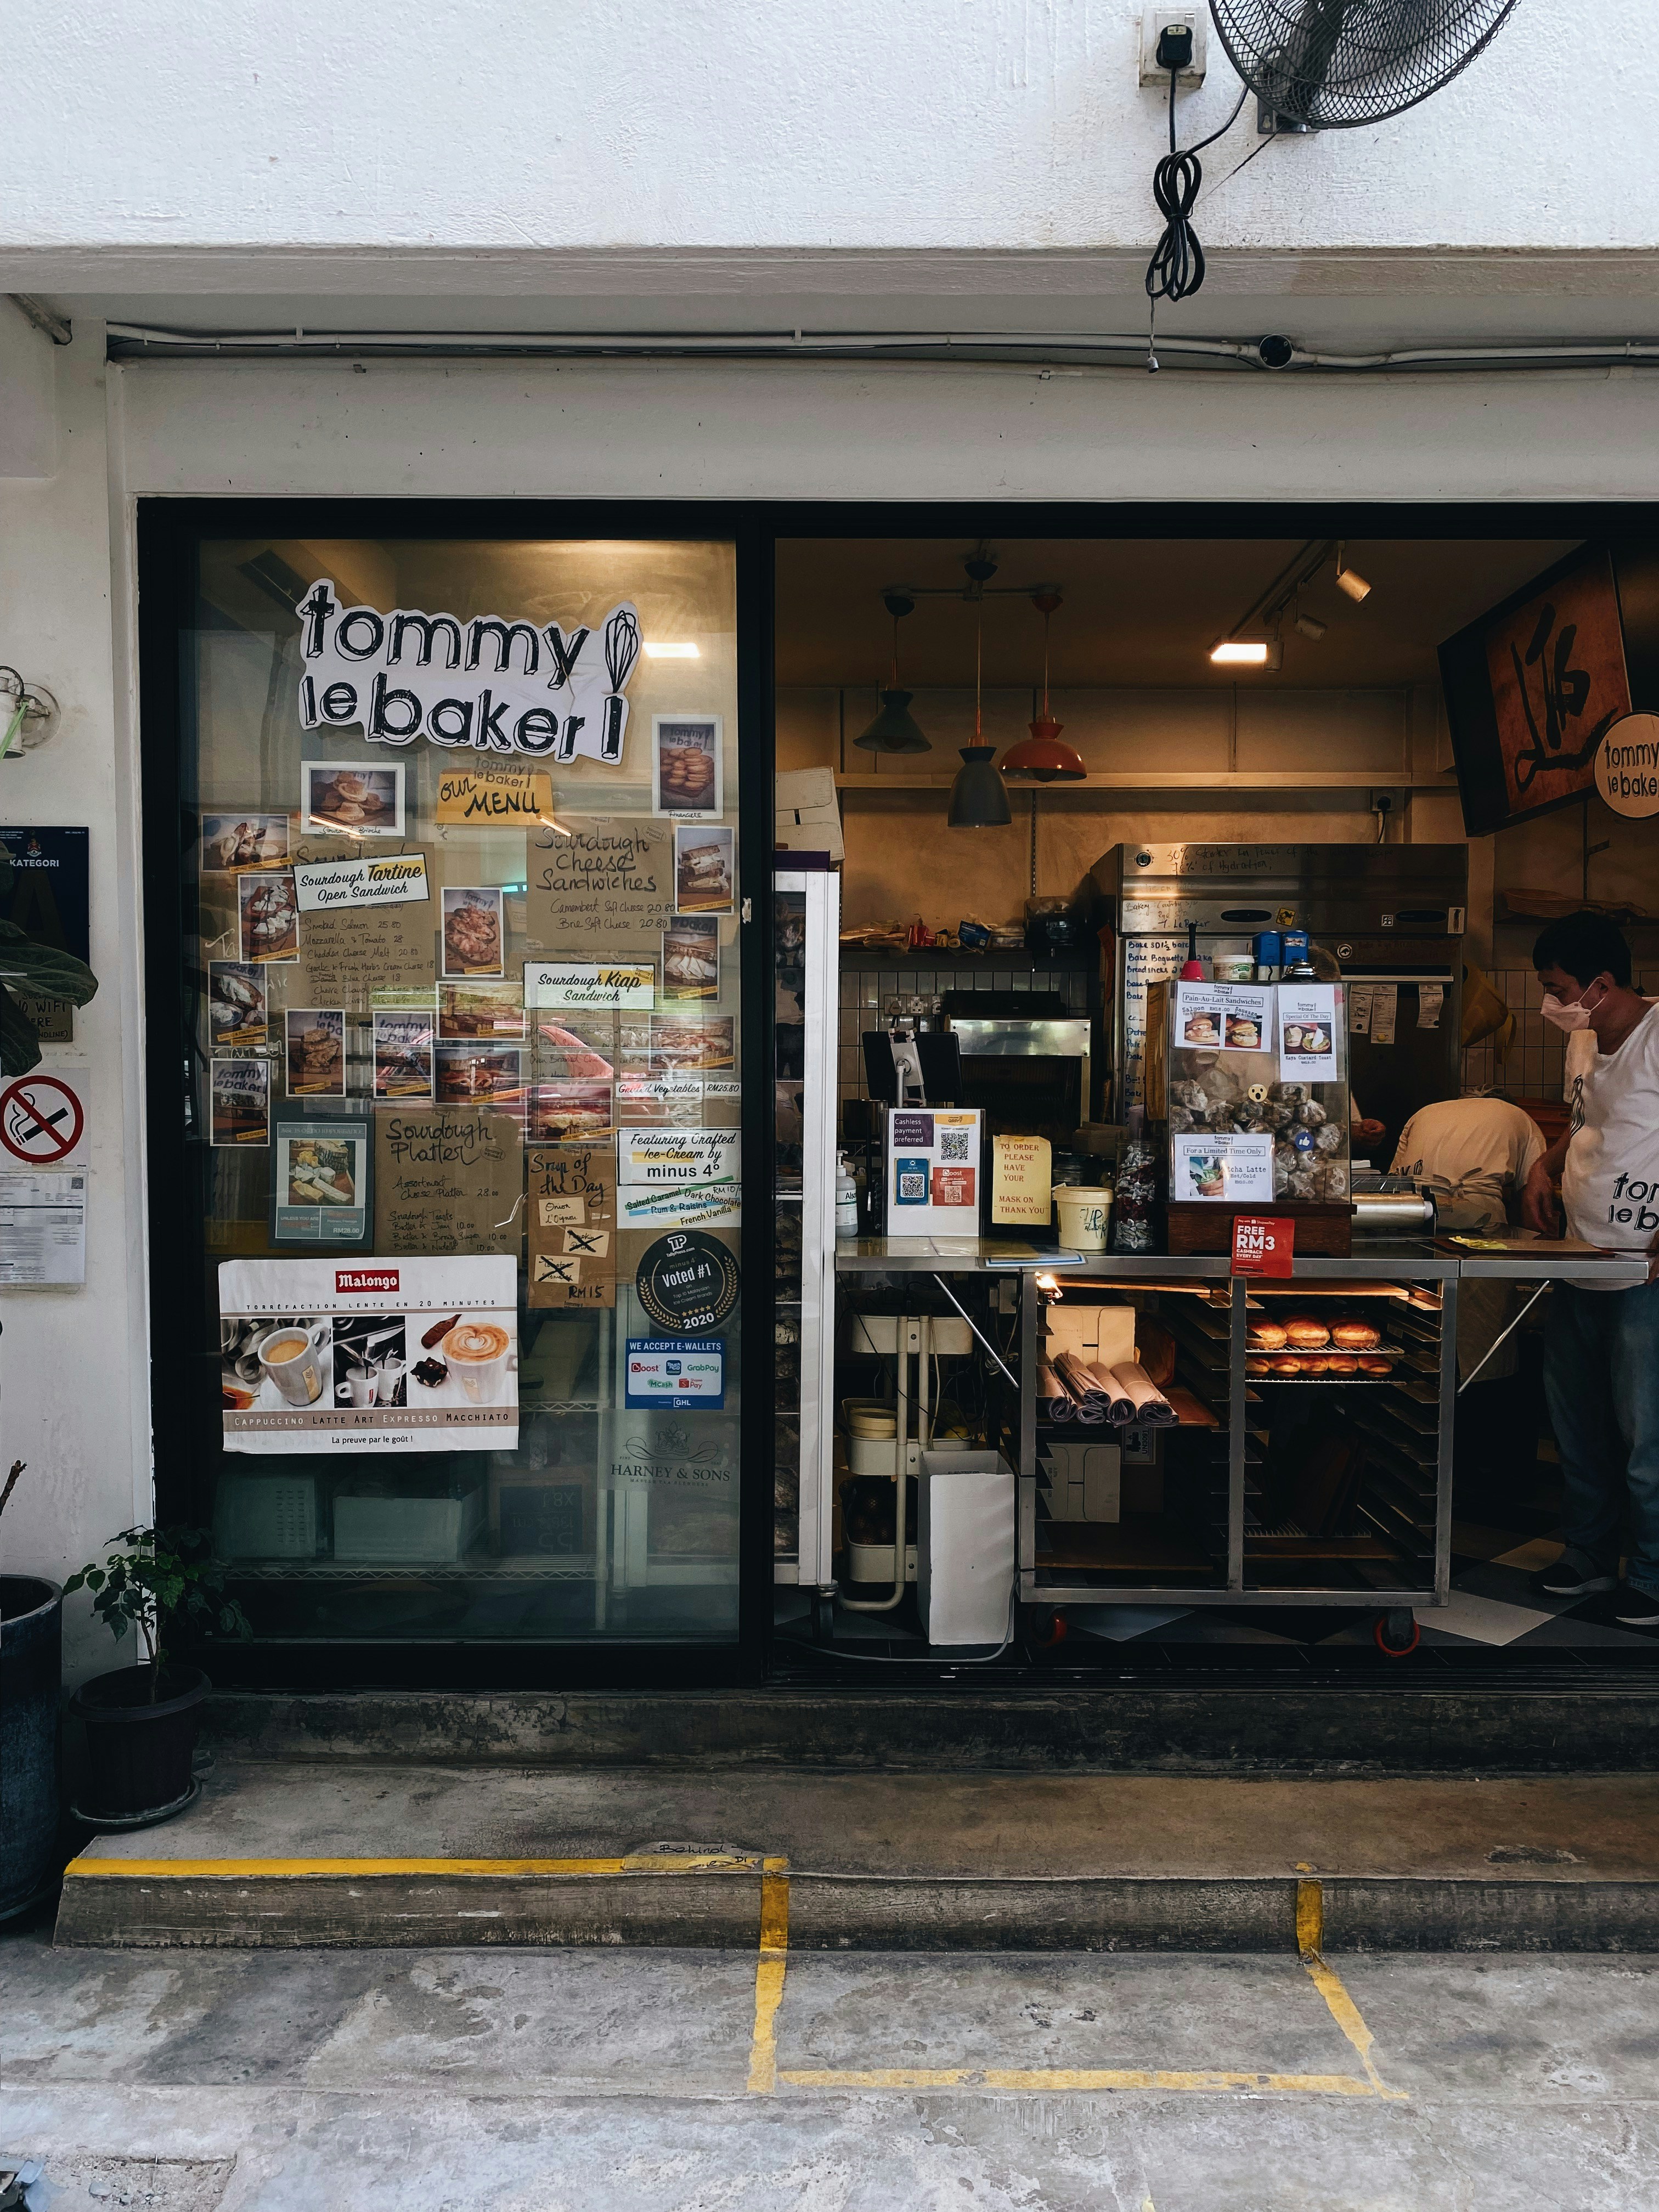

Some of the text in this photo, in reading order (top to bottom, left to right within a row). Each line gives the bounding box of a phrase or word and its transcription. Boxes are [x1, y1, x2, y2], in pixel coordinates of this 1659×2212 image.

[300, 585, 590, 690] tommy
[465, 792, 540, 817] MENU
[535, 826, 650, 861] Sourdough
[556, 851, 636, 872] Cheese
[300, 864, 422, 888] Sourdough Tartine
[536, 868, 657, 891] Sandwiches
[318, 881, 408, 904] Open Sandwich
[301, 933, 346, 946] Mozzarella
[358, 933, 386, 945] Tomato
[393, 934, 404, 943] 28
[370, 946, 390, 958] Melt
[392, 973, 402, 981] 18
[538, 970, 641, 992] Sourdough Kiap
[563, 989, 620, 1001] Sandwich
[1185, 995, 1224, 1003] Pain-Au-Lait
[654, 1082, 740, 1097] Vegetables RM25.80
[386, 1115, 493, 1149] Sourdough
[894, 1135, 924, 1144] preferred
[630, 1133, 687, 1150] Featuring
[691, 1132, 737, 1149] Crafted
[1013, 1143, 1040, 1152] ORDER
[391, 1138, 481, 1166] Platter
[644, 1147, 723, 1164] Ice-Cream by
[1005, 1153, 1035, 1161] PLEASE
[1246, 1148, 1262, 1156] Only
[647, 1164, 697, 1177] minus
[1003, 1174, 1024, 1182] YOUR
[627, 1187, 682, 1210] Salted Caramel
[684, 1188, 741, 1207] Dark Chocolate
[545, 1202, 571, 1211] Onion
[651, 1202, 708, 1215] Rum & Raisins
[680, 1205, 732, 1226] French Vanilla
[1237, 1225, 1265, 1235] FREE
[1237, 1234, 1275, 1250] RM3
[338, 1274, 397, 1290] Malongo
[662, 1263, 712, 1288] Voted #1
[681, 1295, 697, 1304] Cream
[697, 1290, 713, 1299] Brands
[687, 1285, 710, 1295] Malaysian
[683, 1312, 715, 1329] 2020
[629, 1342, 721, 1351] WE ACCEPT E-WALLETS
[687, 1364, 719, 1373] GrabPay
[234, 1413, 509, 1426] CAPPUCCINO LATTE ART EXPRESSO MACCHIATO
[342, 1437, 368, 1446] preuve
[368, 1437, 381, 1446] par
[391, 1435, 409, 1444] goût
[611, 1464, 731, 1482] HARNEY & SONS
